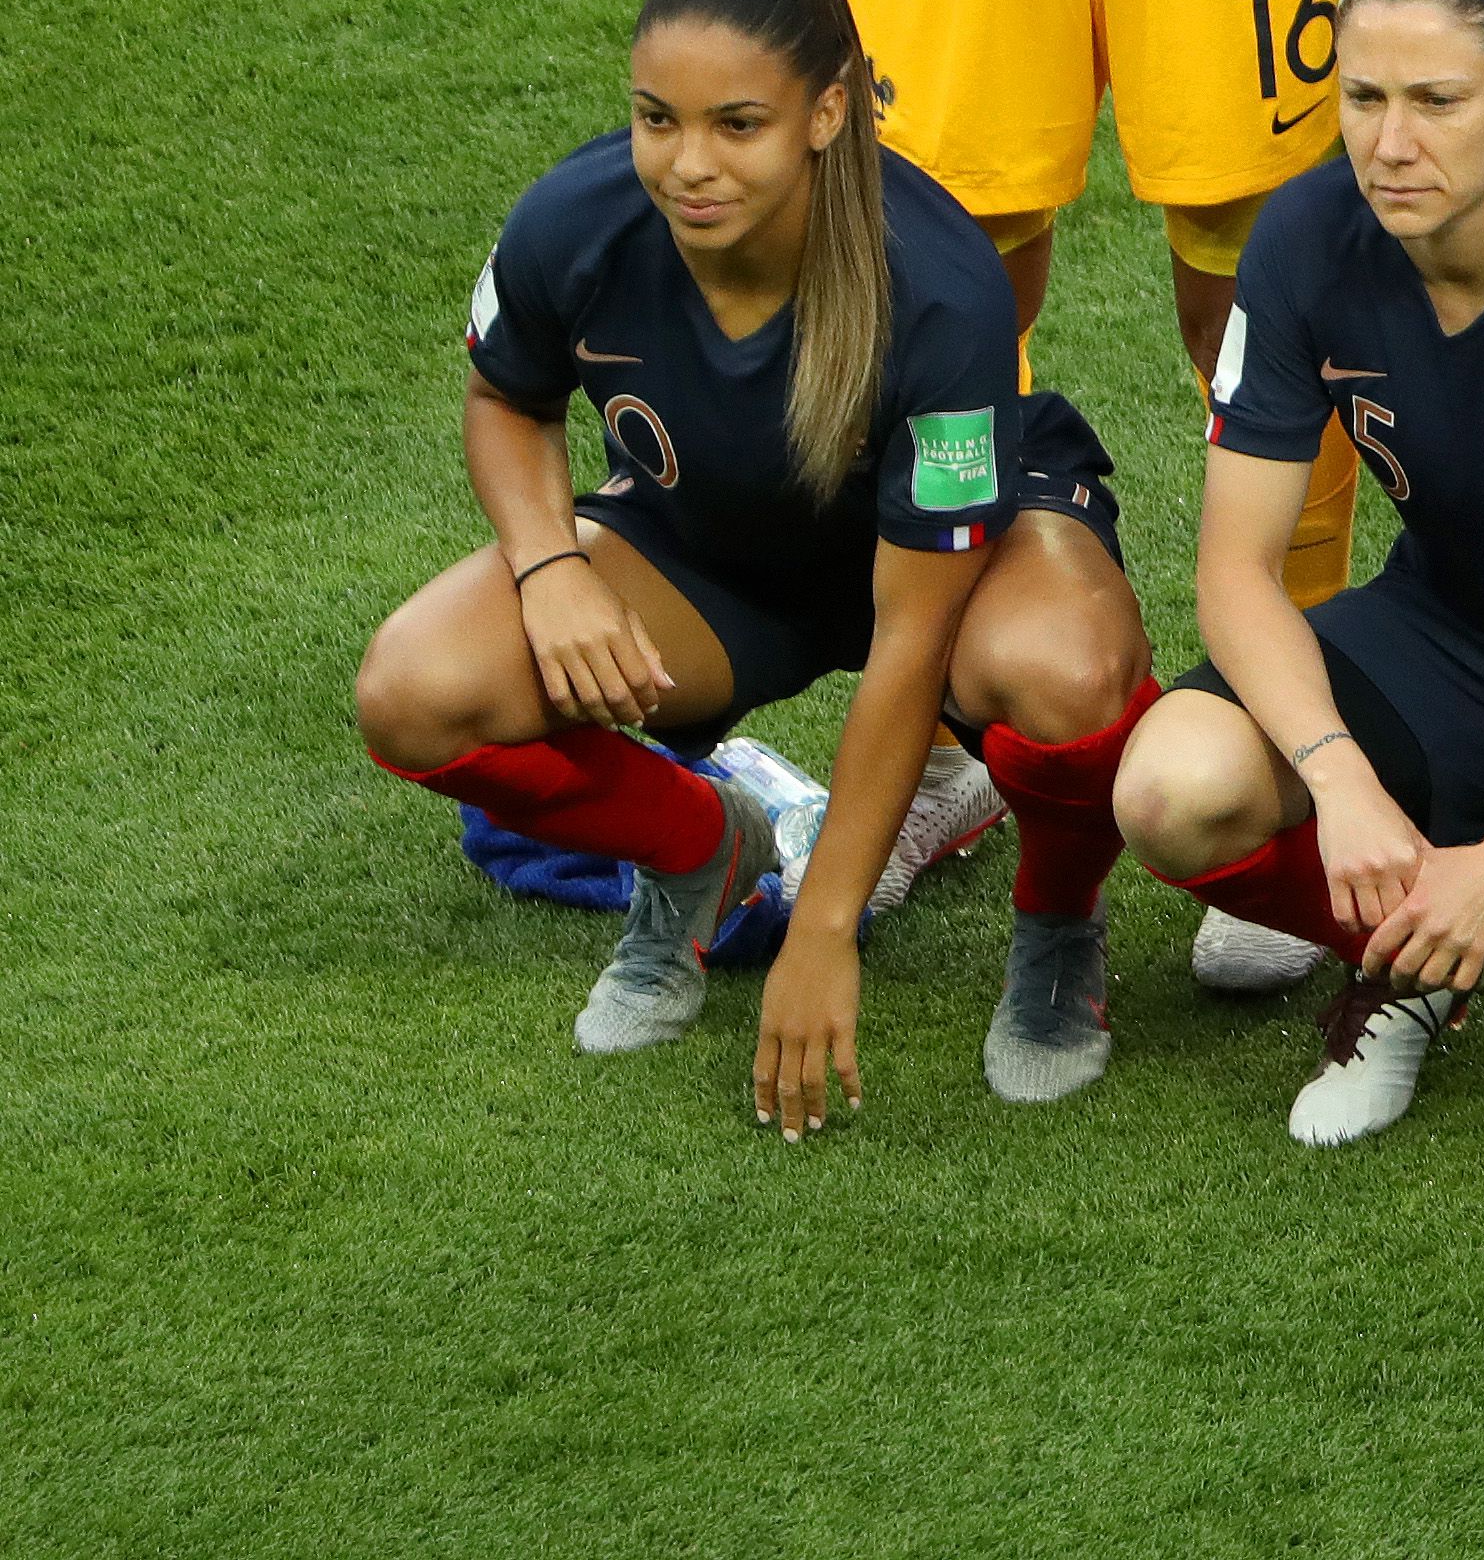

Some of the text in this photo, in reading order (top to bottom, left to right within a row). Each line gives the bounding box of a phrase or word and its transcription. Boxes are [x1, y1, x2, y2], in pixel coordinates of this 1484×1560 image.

[921, 434, 987, 452] LIVING
[1351, 393, 1410, 502] 5
[959, 463, 988, 483] FIFA
